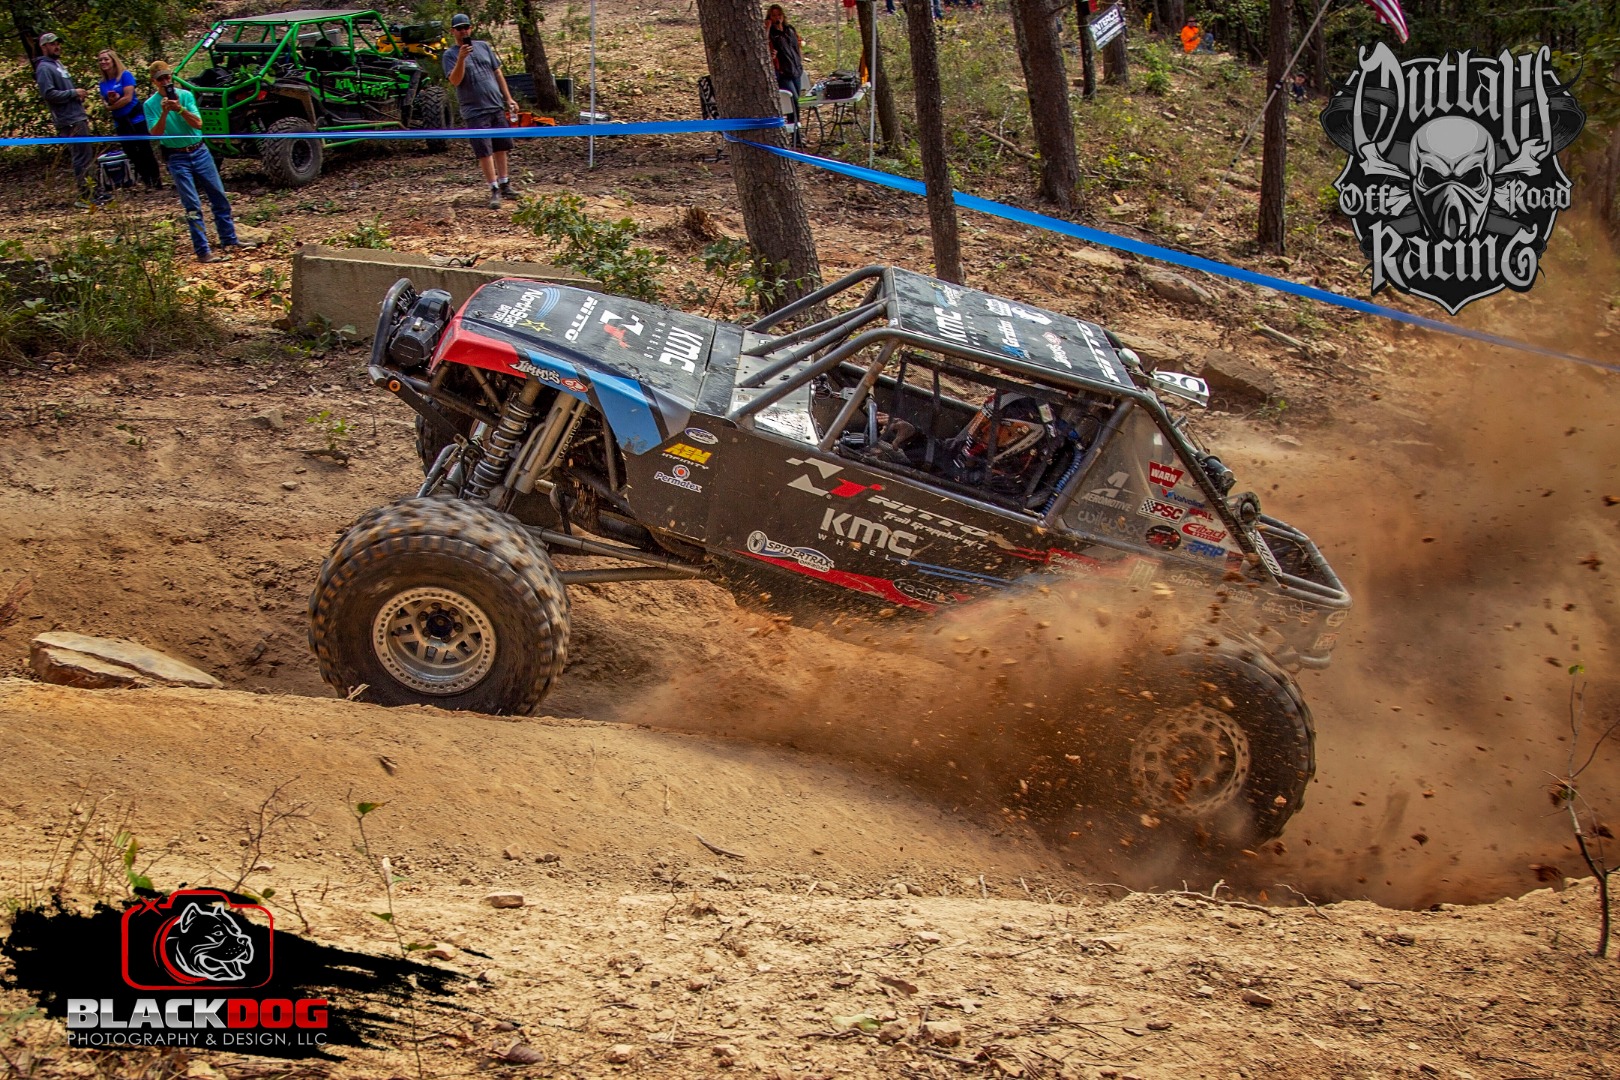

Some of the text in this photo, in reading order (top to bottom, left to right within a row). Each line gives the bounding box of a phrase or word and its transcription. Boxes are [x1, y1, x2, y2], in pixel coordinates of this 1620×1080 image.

[565, 296, 598, 342] NITTO
[933, 306, 969, 344] KMC
[659, 326, 704, 374] KMC
[663, 443, 712, 464] AEM
[655, 471, 702, 492] Permatex
[1151, 468, 1177, 483] WARN
[868, 495, 990, 536] NITTO
[1081, 493, 1133, 512] AEROMOTIVE
[1152, 502, 1183, 520] PSC
[820, 507, 918, 556] KMC
[883, 511, 912, 526] Trail
[912, 519, 964, 542] Grappler
[1182, 522, 1227, 540] Eibach
[767, 541, 834, 568] SPIDERTRAX
